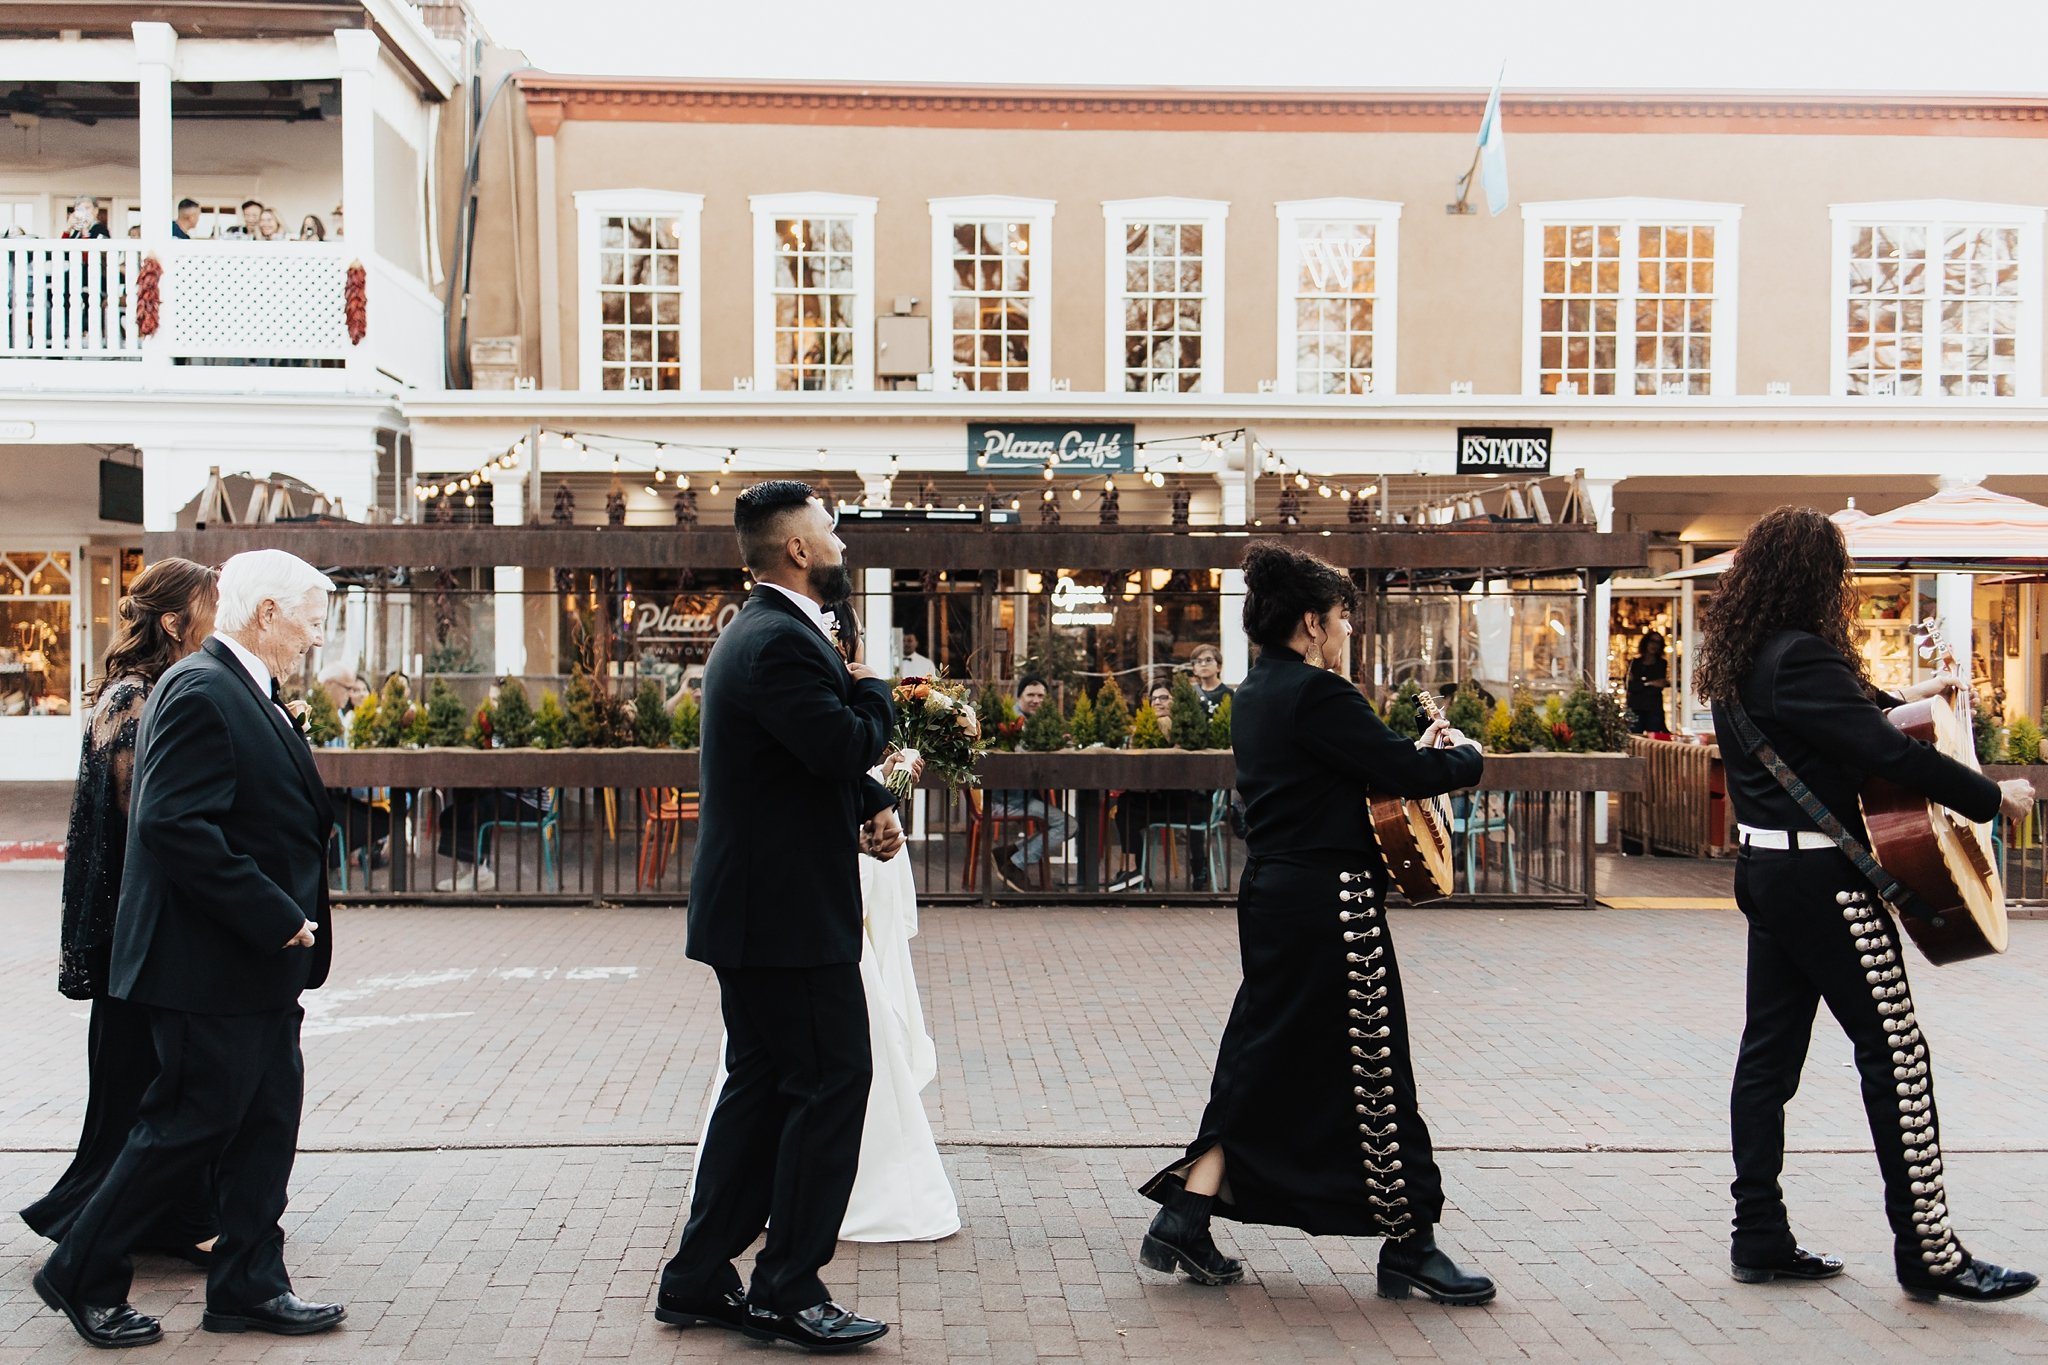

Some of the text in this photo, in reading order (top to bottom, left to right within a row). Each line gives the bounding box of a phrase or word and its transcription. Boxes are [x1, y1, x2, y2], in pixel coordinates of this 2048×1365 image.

[983, 430, 1121, 468] Plaza Café
[1461, 438, 1547, 464] ESTATES
[636, 603, 714, 635] Plaza
